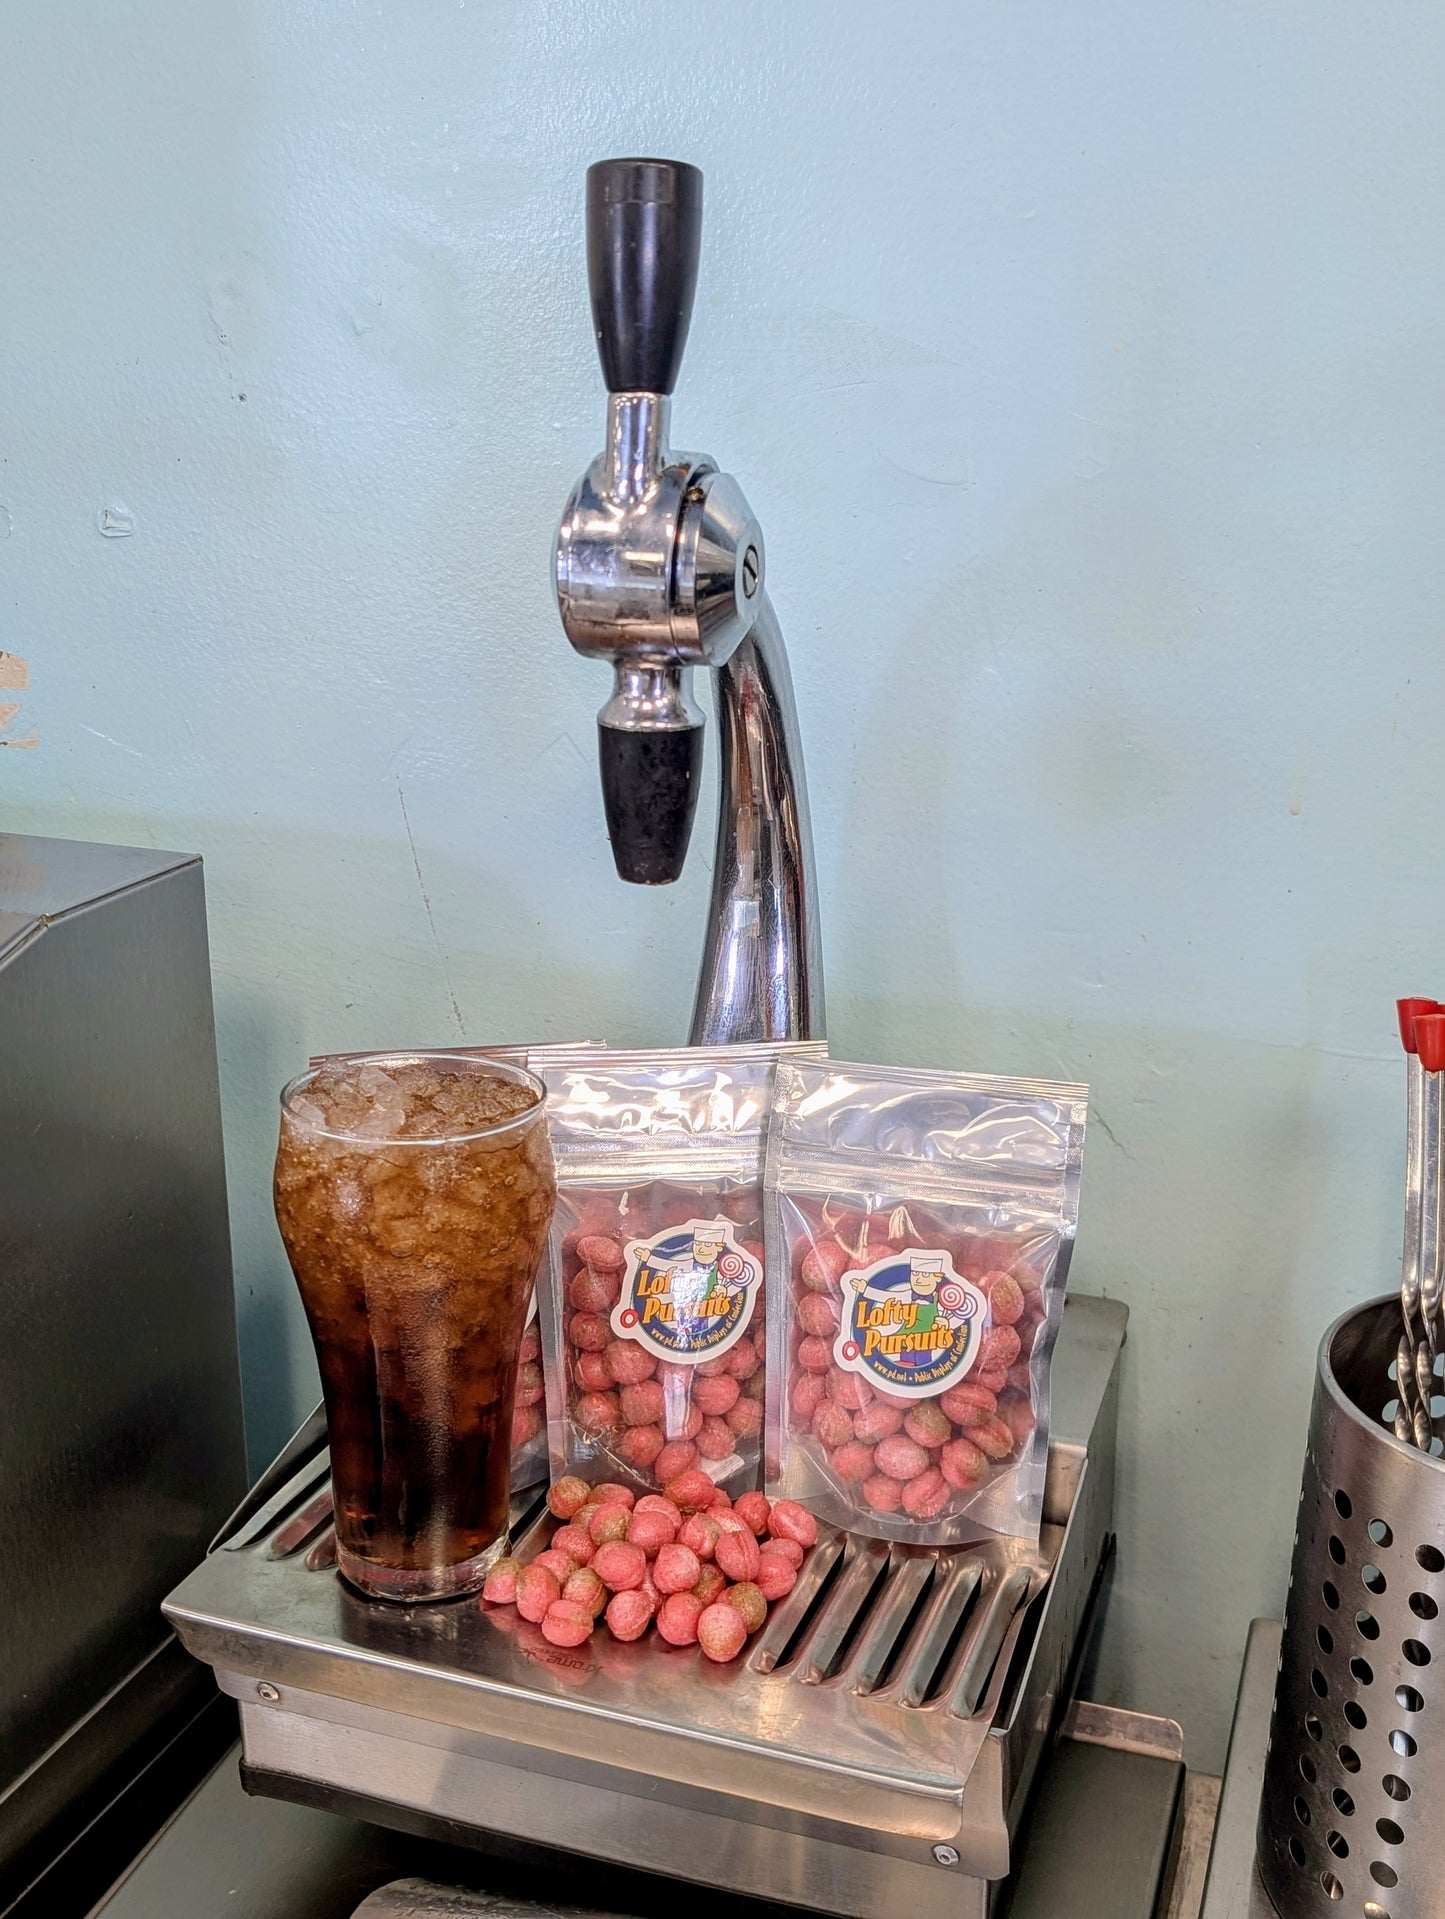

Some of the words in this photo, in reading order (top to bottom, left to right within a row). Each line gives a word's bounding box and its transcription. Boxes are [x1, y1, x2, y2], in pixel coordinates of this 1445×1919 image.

[637, 1266, 698, 1297] Lof
[642, 1292, 731, 1324] Pusuits
[856, 1298, 918, 1329] Lofty
[864, 1323, 953, 1356] Pursuits
[873, 1361, 906, 1382] www.pd.net
[915, 1372, 932, 1383] Public
[932, 1361, 953, 1377] Displays
[951, 1352, 958, 1362] of
